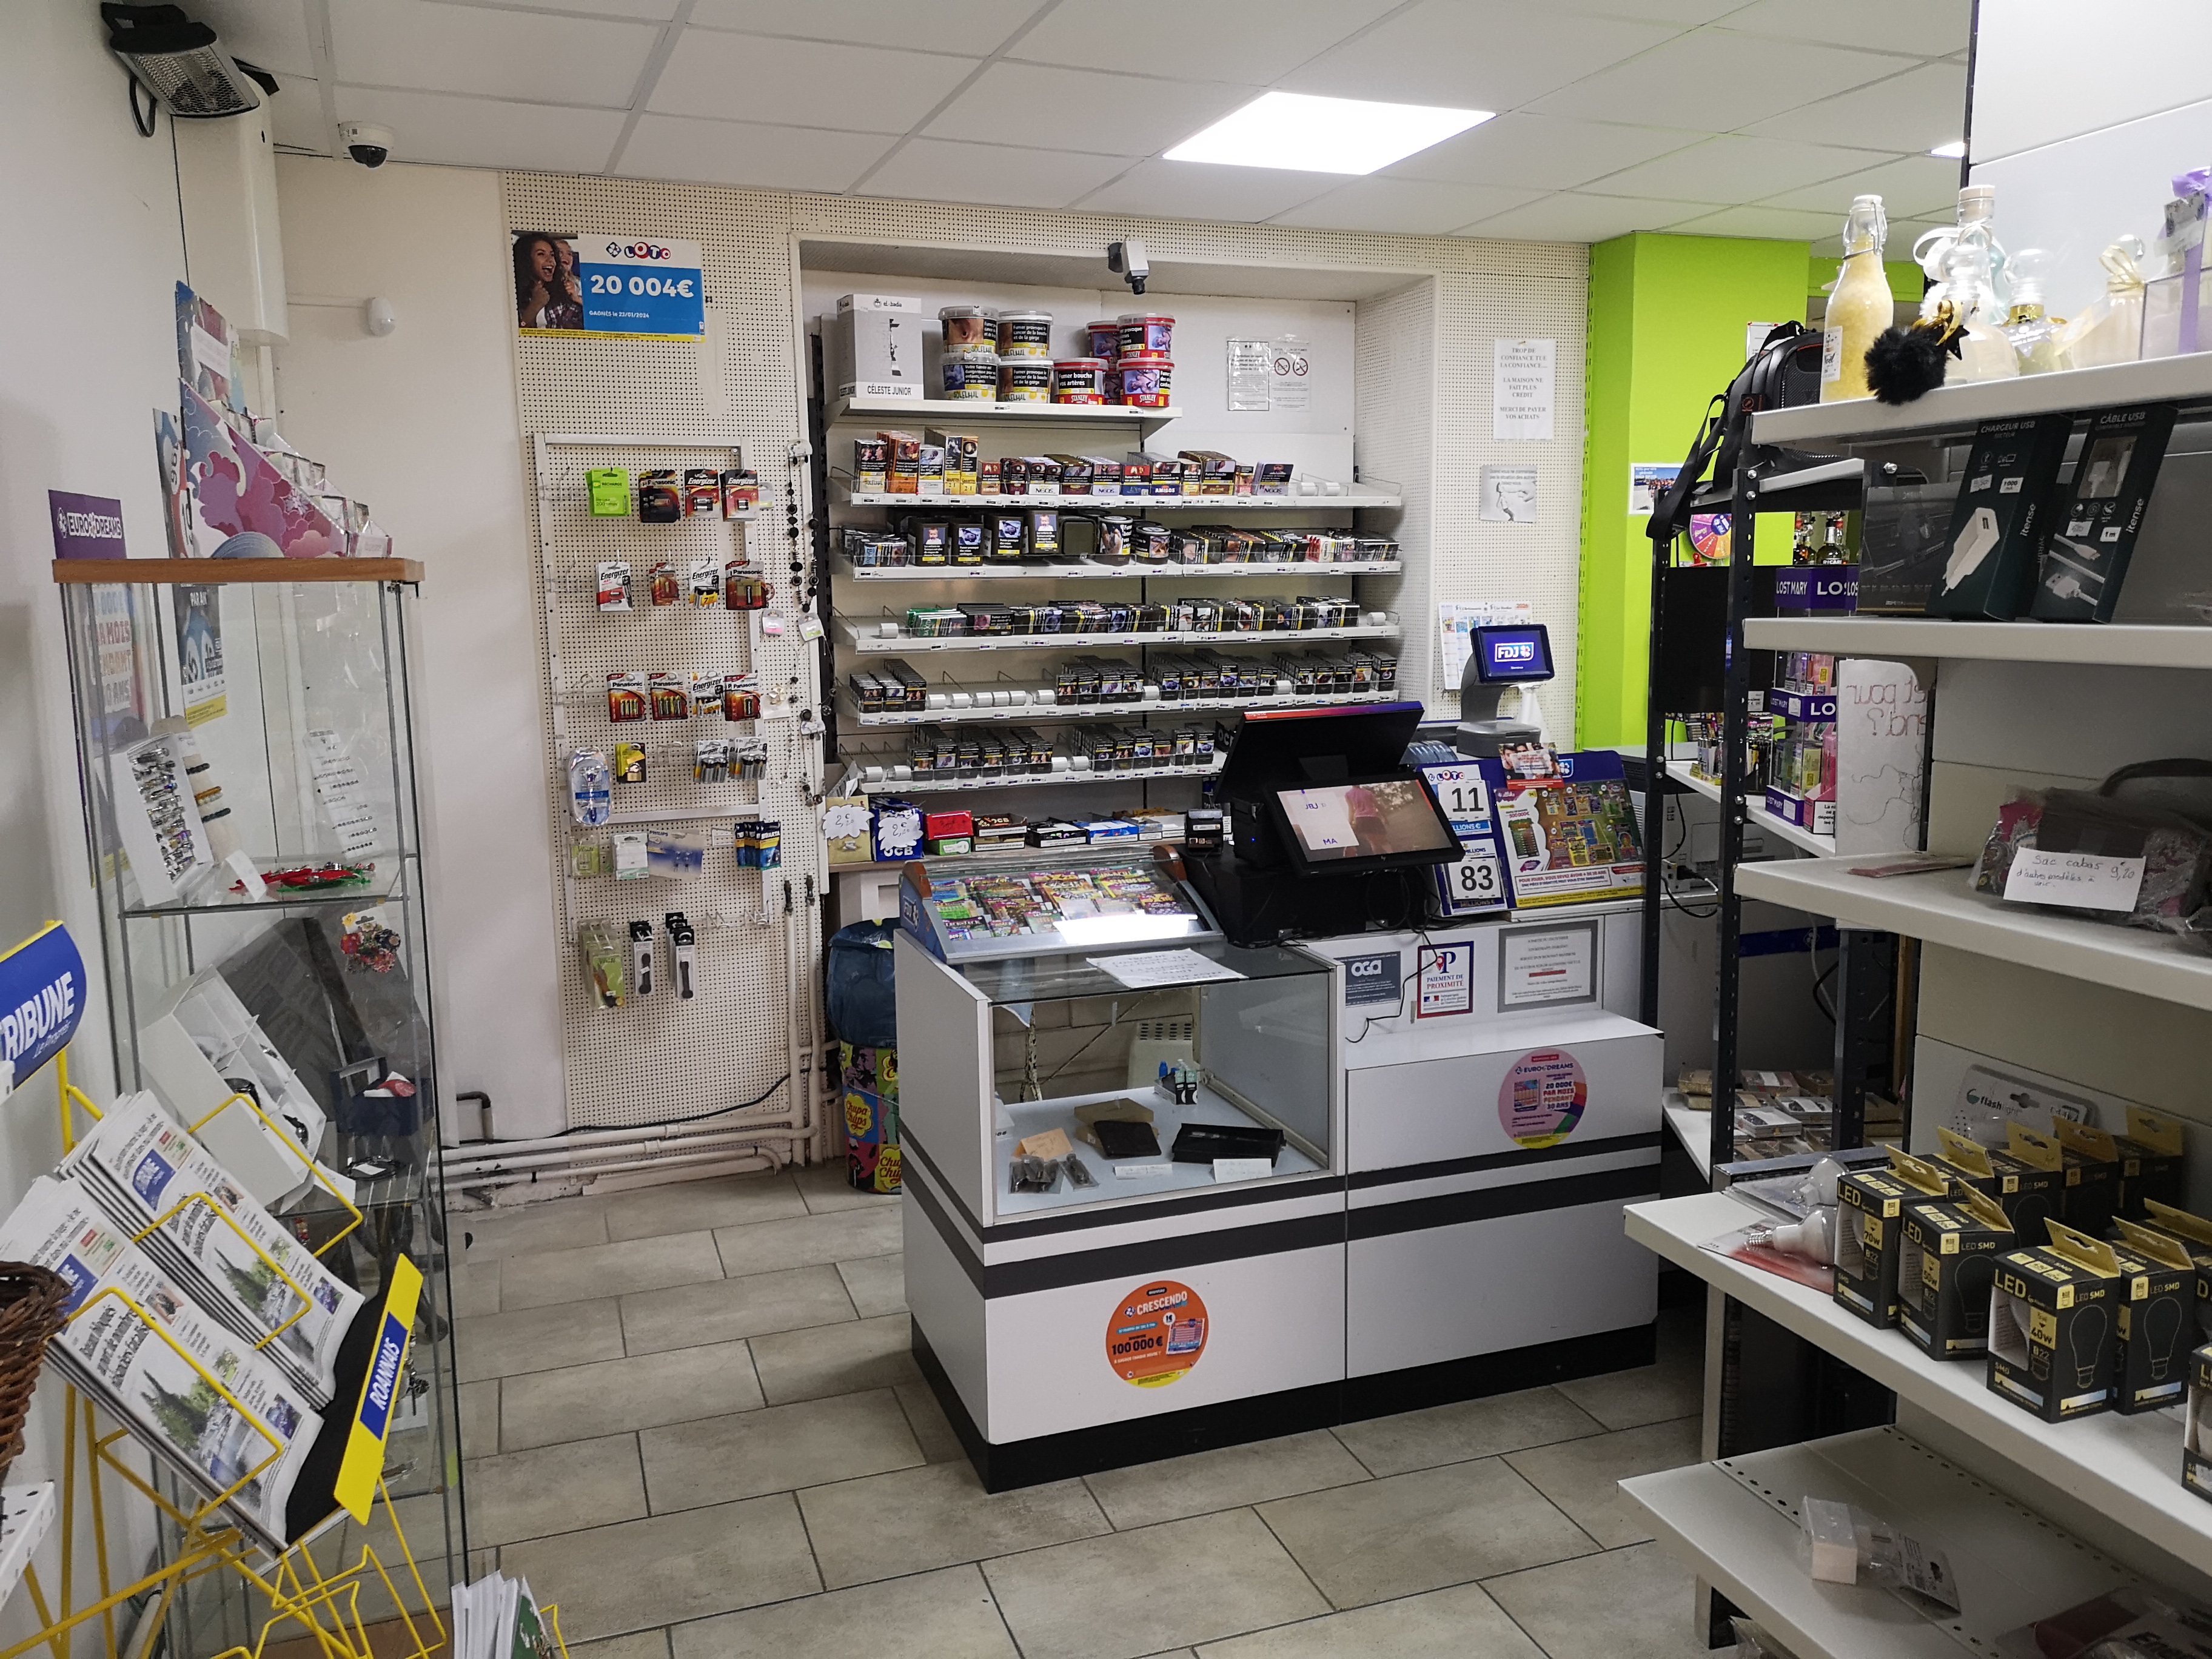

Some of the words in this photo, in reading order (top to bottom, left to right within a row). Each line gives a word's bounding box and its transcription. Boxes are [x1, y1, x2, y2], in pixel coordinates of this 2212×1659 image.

[625, 241, 671, 260] LOTO
[591, 275, 622, 294] 20
[629, 276, 694, 298] 004€
[867, 384, 891, 395] CÉLESTE
[892, 387, 911, 395] JUNIOR
[2128, 411, 2146, 421] USB
[1981, 421, 2020, 434] CHARGEUR
[2020, 421, 2036, 429] USB
[688, 477, 717, 486] Energizer
[728, 477, 756, 485] Energizer
[600, 568, 629, 580] Energizer
[692, 568, 719, 580] Energizer
[1776, 581, 1790, 595] LOST
[1791, 581, 1808, 595] MARY
[1498, 646, 1519, 659] FDJ
[692, 677, 723, 691] Energizer
[1437, 770, 1465, 781] LOTO
[1451, 787, 1484, 813] 11
[883, 846, 913, 857] OCB
[2032, 855, 2057, 866] Sac
[2066, 857, 2104, 871] cabas
[1461, 865, 1493, 891] 83
[1440, 951, 1456, 974] P
[1427, 980, 1465, 990] PROXIMITÉ
[1, 971, 75, 1061] RIBUNE
[846, 1101, 868, 1116] Chupa
[846, 1111, 867, 1130] Chups
[2033, 1180, 2049, 1189] SMD
[1837, 1181, 1861, 1207] LED
[1902, 1216, 1922, 1244] LED
[1961, 1242, 1977, 1251] LED
[1866, 1250, 1879, 1260] B22
[1994, 1269, 2026, 1298] LED
[2164, 1281, 2180, 1292] SMD
[2076, 1293, 2089, 1302] LED
[2090, 1289, 2105, 1299] SMD
[1137, 1291, 1188, 1316] CRESCENDO
[1111, 1342, 1131, 1356] 100
[1133, 1338, 1155, 1352] 000
[1156, 1336, 1164, 1347] €
[2033, 1345, 2050, 1359] B22
[369, 1337, 401, 1410] ROANNAIS
